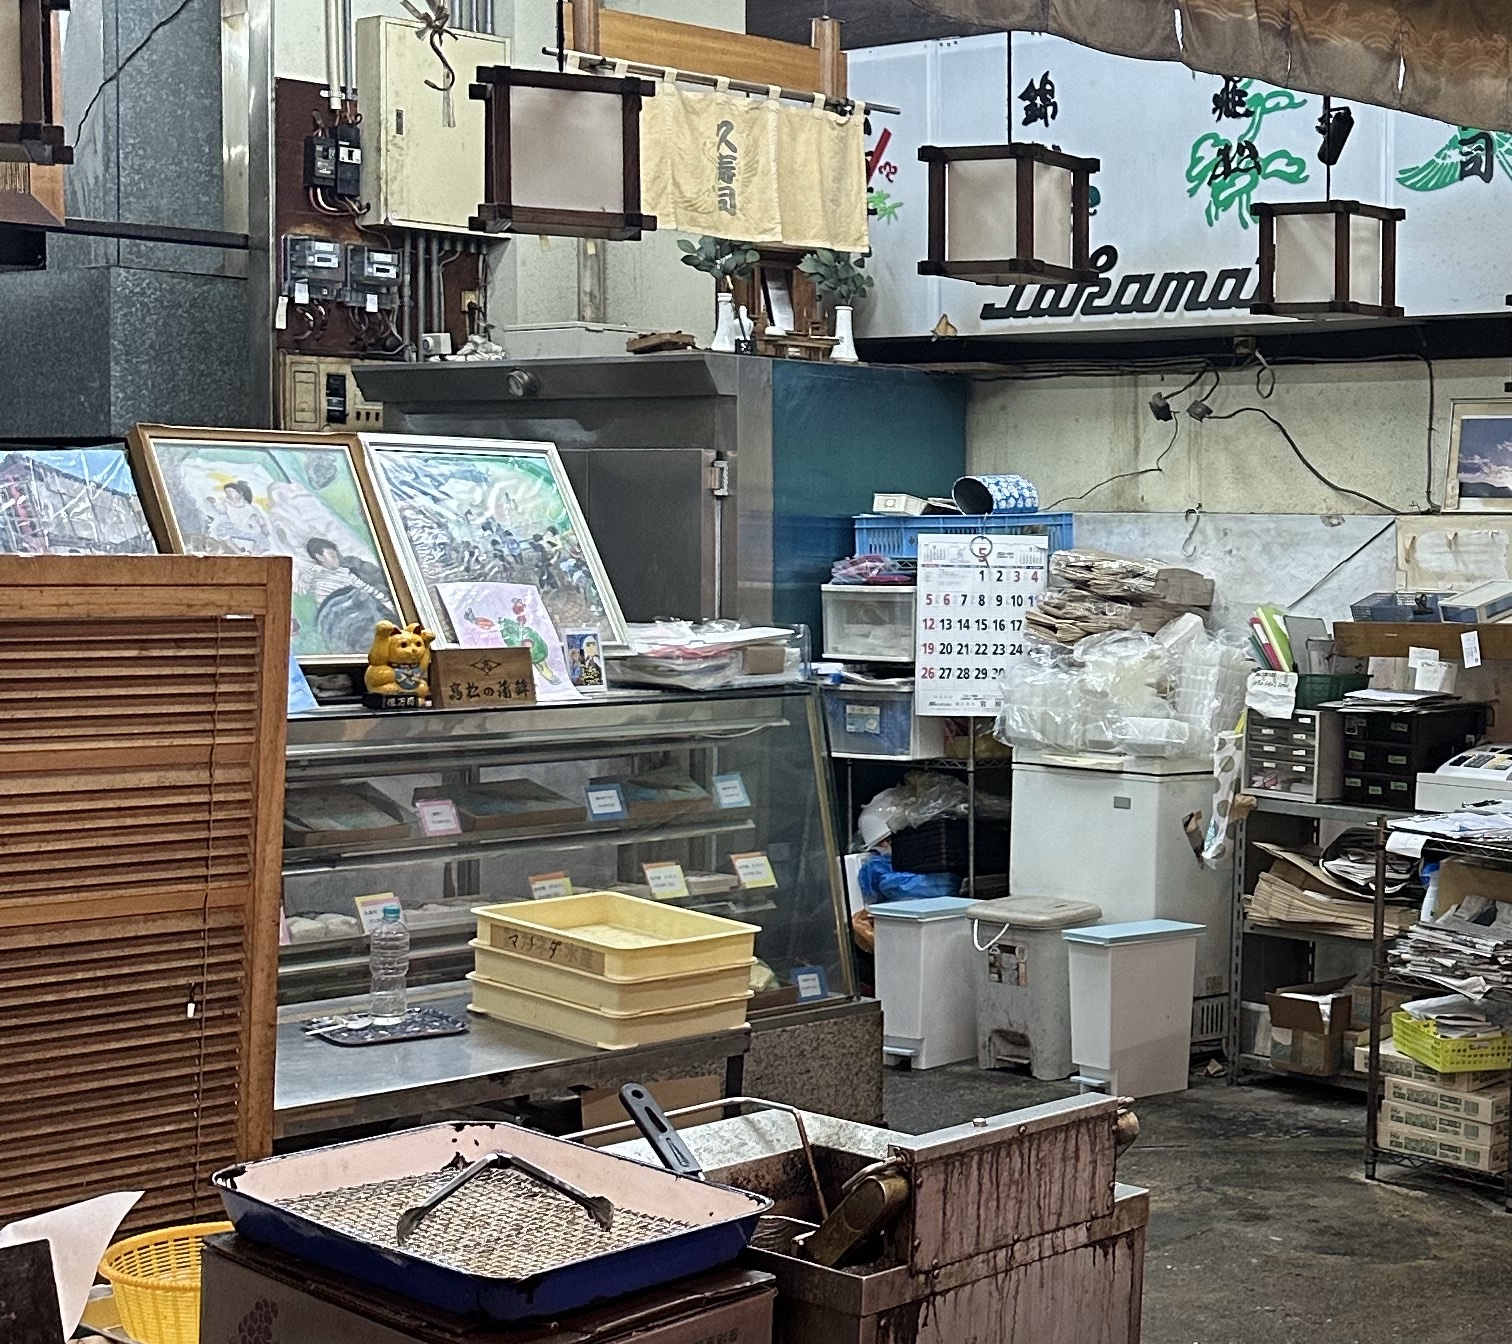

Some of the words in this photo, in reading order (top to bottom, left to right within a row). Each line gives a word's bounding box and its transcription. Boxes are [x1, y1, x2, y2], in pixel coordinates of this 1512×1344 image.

[980, 570, 985, 582] 1
[996, 570, 1004, 582] 2
[1014, 570, 1021, 582] 3
[1031, 571, 1039, 583] 4
[925, 594, 933, 606] 5
[943, 594, 951, 606] 6
[961, 594, 968, 606] 7
[978, 594, 986, 607] 8
[995, 594, 1003, 607] 9
[1011, 594, 1023, 607] 10
[922, 618, 935, 630] 12
[939, 618, 952, 631] 13
[957, 618, 970, 631] 14
[975, 619, 988, 631] 15
[992, 619, 1006, 631] 16
[1010, 619, 1023, 632] 17
[922, 642, 935, 655] 19
[939, 642, 953, 655] 20
[957, 643, 970, 655] 21
[974, 643, 988, 656] 22
[992, 643, 1006, 656] 23
[1009, 643, 1023, 656] 24
[921, 667, 935, 679] 26
[939, 667, 952, 679] 27
[956, 667, 970, 680] 28
[974, 668, 988, 680] 29
